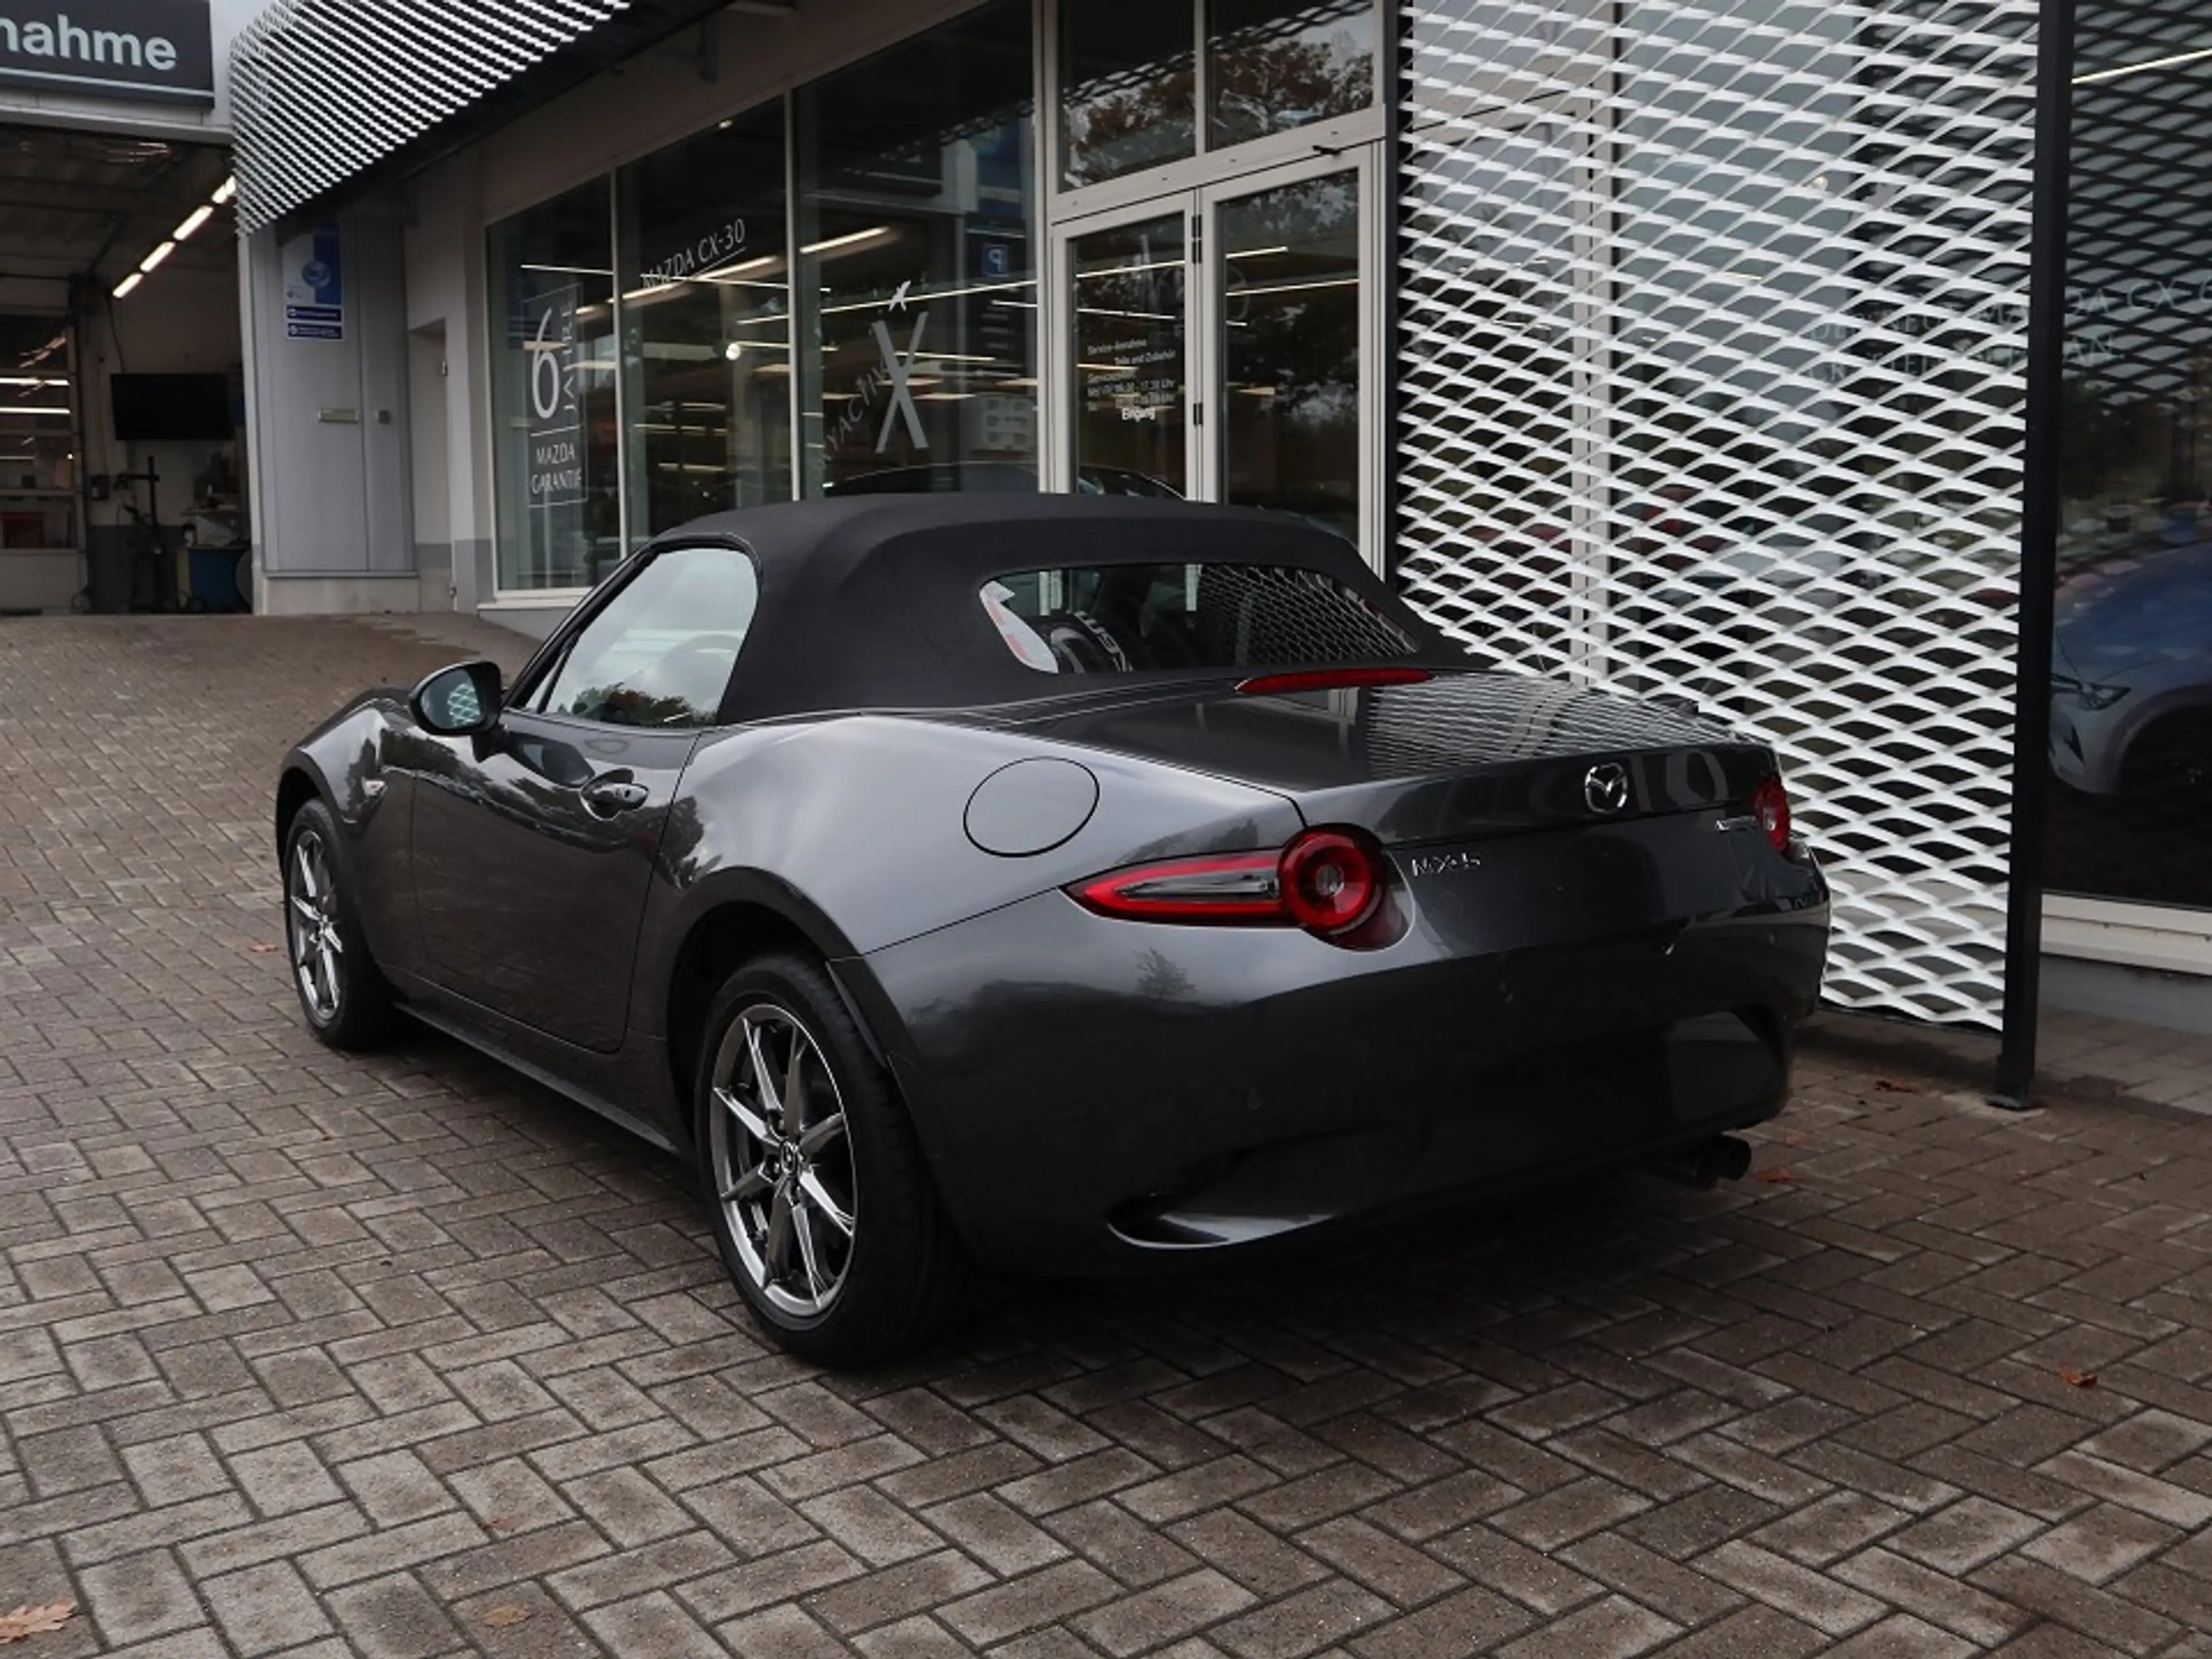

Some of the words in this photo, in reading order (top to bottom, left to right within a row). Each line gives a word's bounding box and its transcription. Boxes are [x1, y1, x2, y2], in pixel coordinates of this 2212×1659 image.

[0, 13, 177, 70] nahme
[641, 248, 695, 288] MAZDA
[698, 218, 745, 262] CX-30
[532, 306, 560, 419] 6
[561, 297, 577, 411] JAHRE
[871, 312, 929, 454] X
[531, 467, 582, 495] GARANTIE
[536, 441, 575, 464] MAZDA
